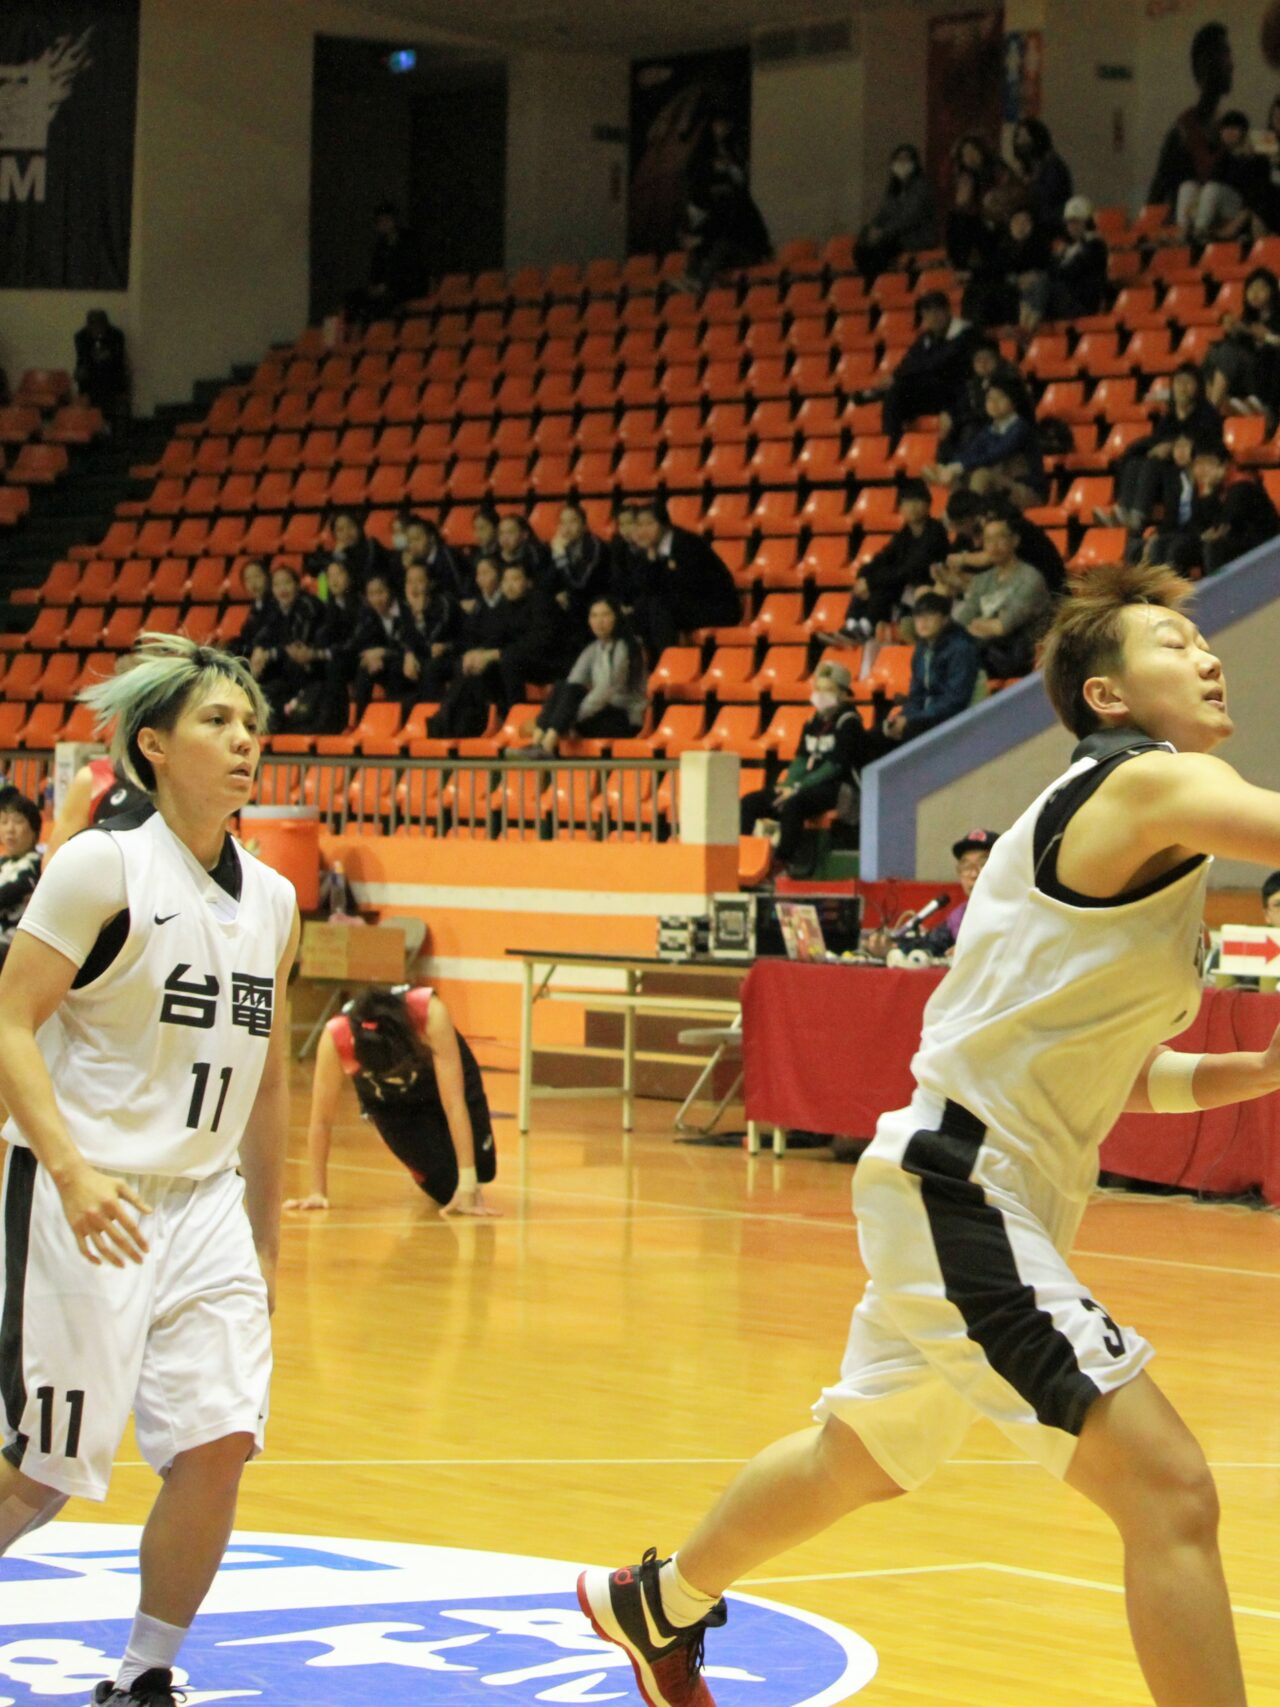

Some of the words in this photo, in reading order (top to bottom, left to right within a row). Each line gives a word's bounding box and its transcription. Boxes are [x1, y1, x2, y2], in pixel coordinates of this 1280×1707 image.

[159, 963, 274, 1038] 台電
[186, 1062, 233, 1132] 11
[37, 1386, 85, 1458] 11
